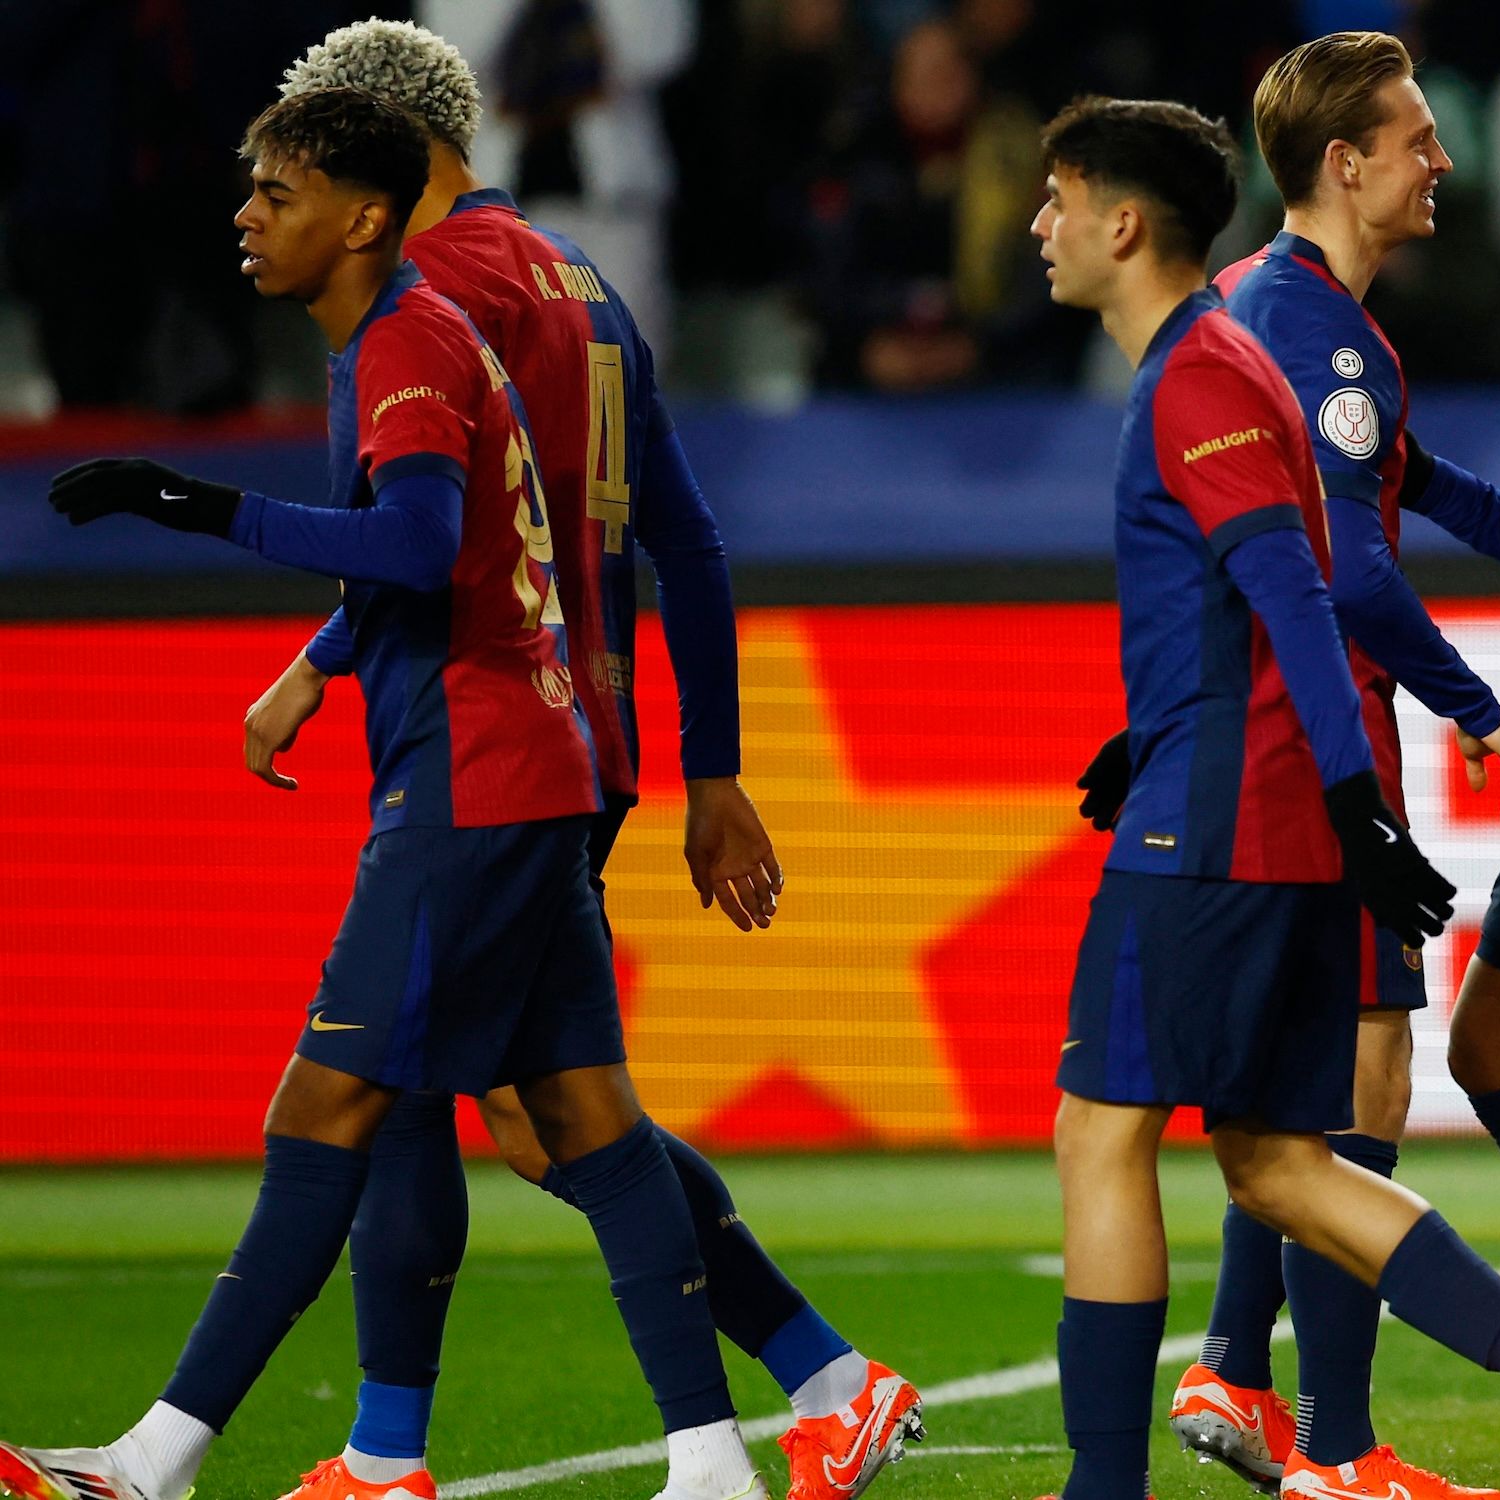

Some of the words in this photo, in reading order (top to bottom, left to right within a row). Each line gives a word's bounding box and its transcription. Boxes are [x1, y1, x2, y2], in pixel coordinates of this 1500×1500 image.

[529, 262, 562, 301] R.
[1341, 358, 1356, 368] 31
[586, 340, 631, 554] 4
[1183, 427, 1260, 465] AMBILIGHT
